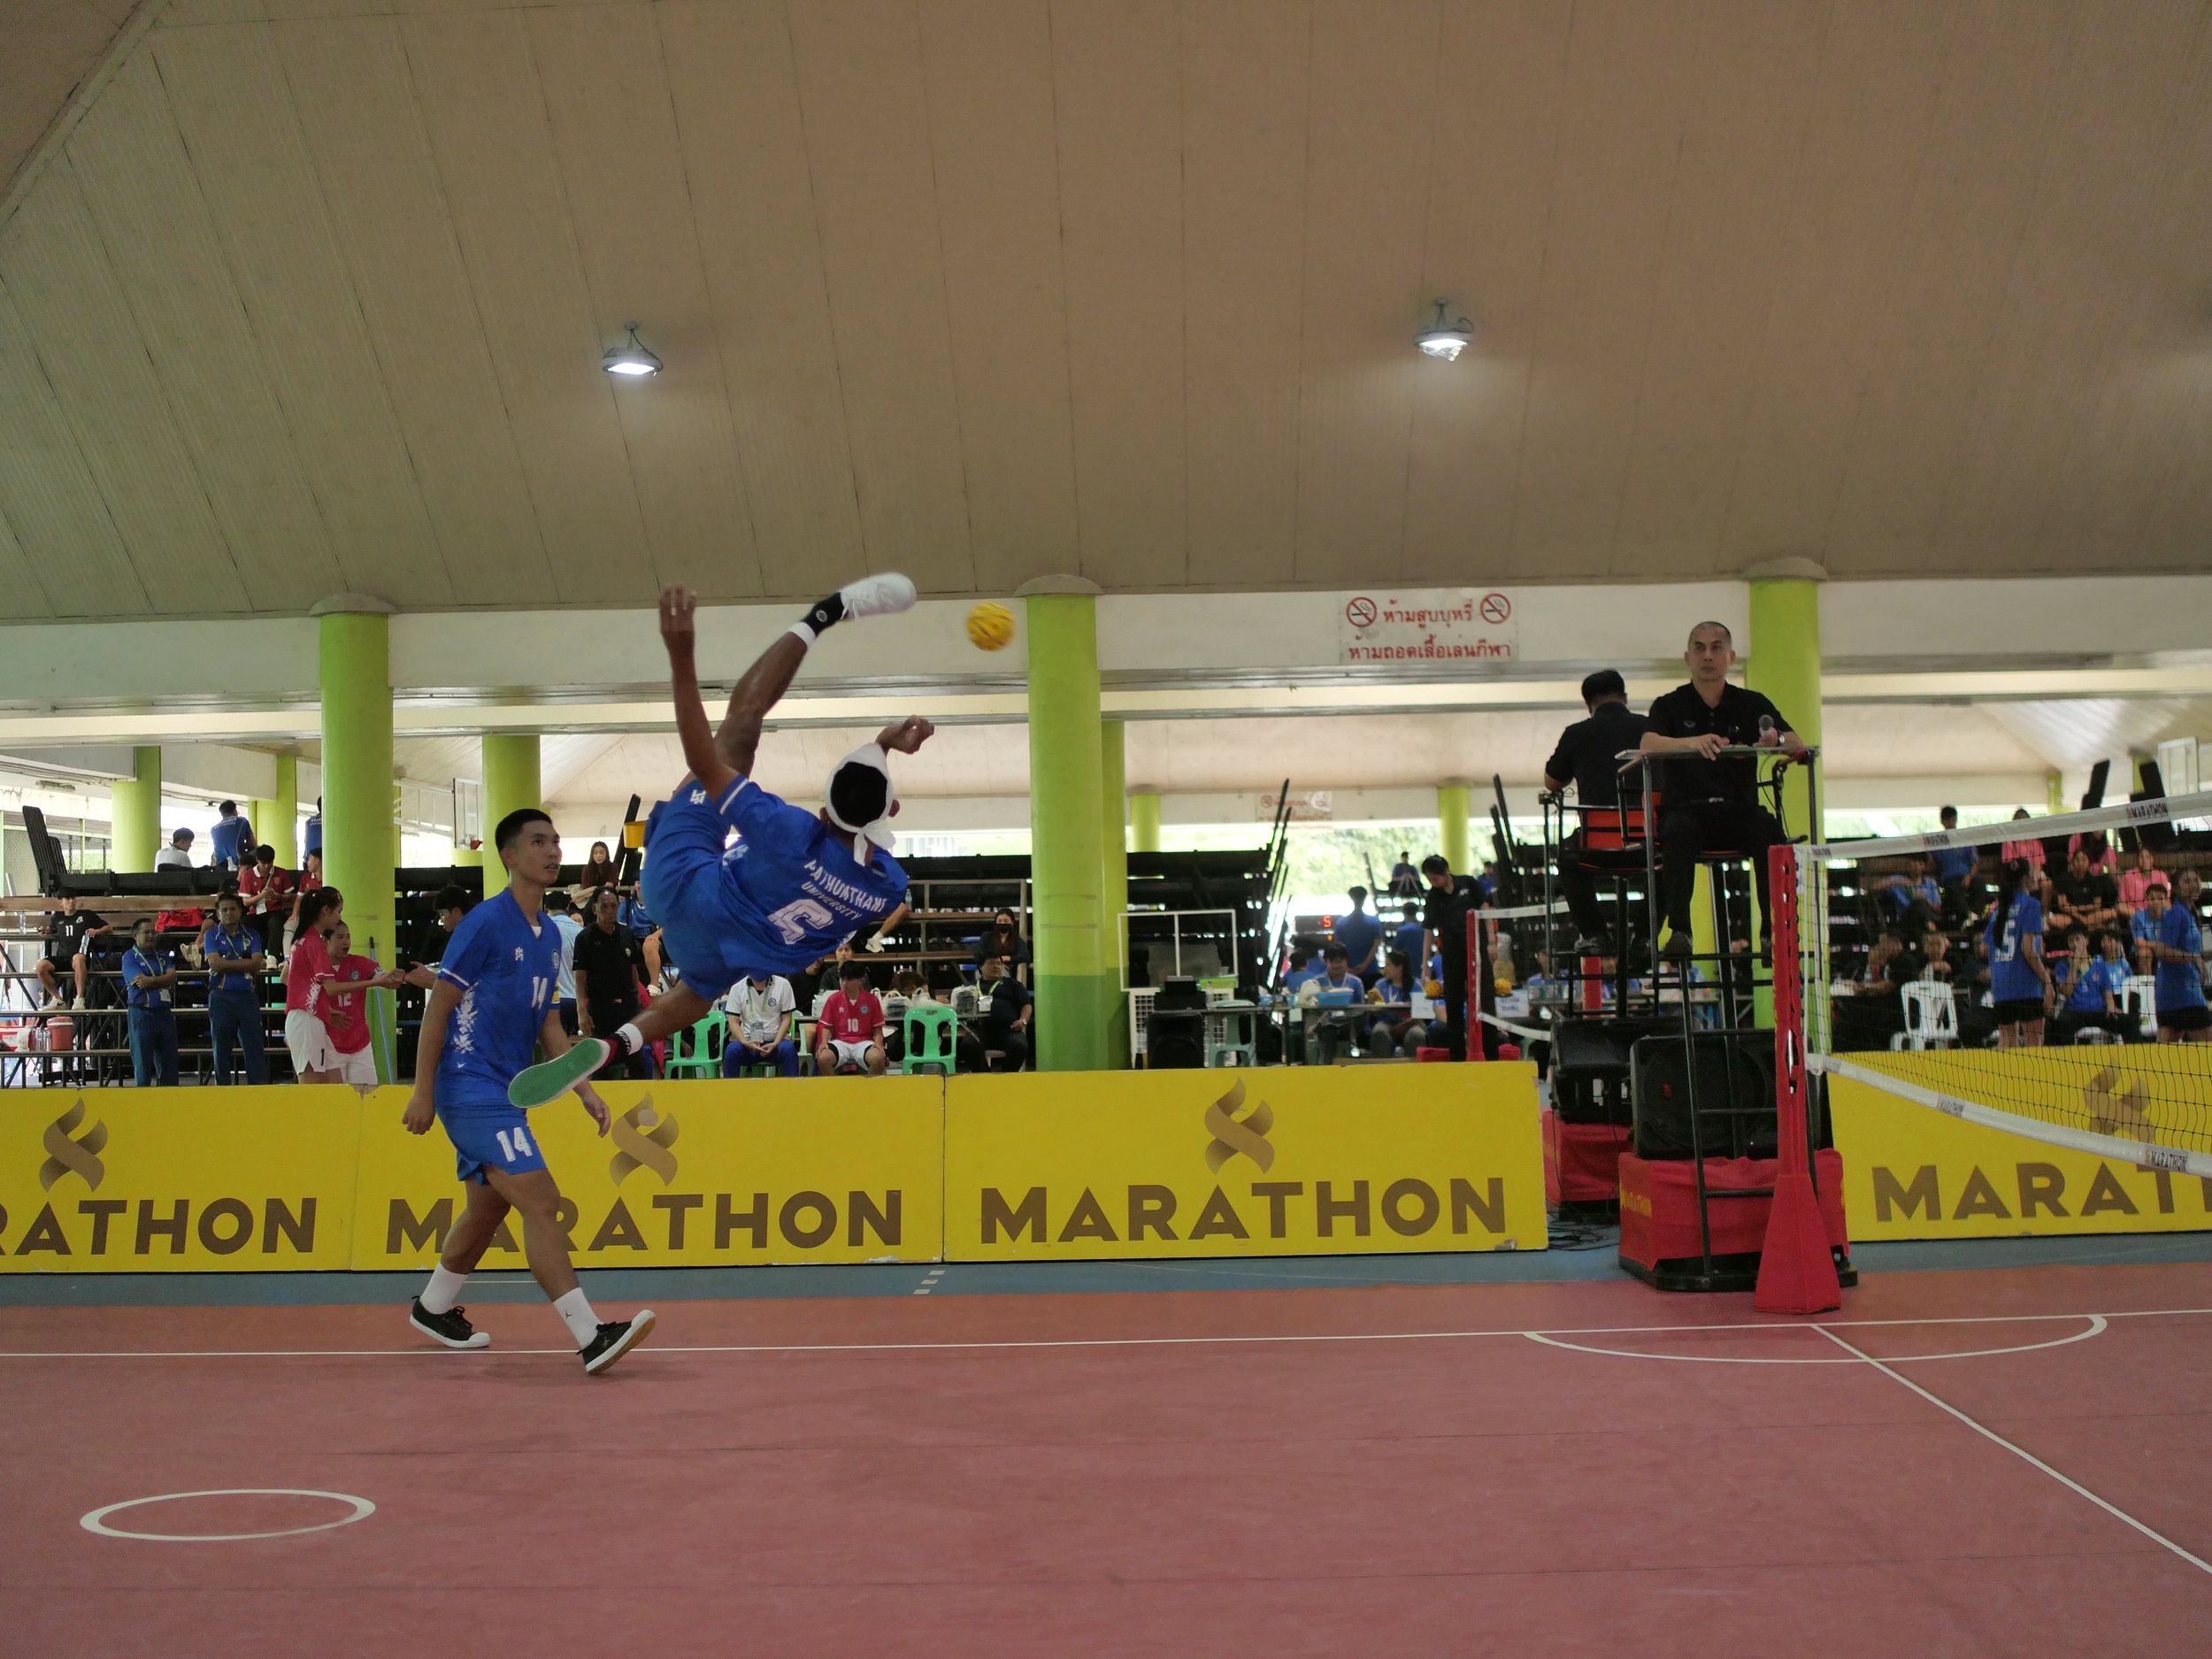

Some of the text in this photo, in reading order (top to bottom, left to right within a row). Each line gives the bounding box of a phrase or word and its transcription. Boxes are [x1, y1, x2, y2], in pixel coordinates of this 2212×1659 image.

[1383, 598, 1473, 628] ห้ามสูบบุหรี่
[1348, 634, 1510, 660] ห้ามถอดเสื้อเล่นกีฬา
[801, 881, 863, 921] UNIVERSITY
[65, 926, 73, 936] 11
[337, 992, 352, 1008] 12
[847, 1018, 858, 1033] 10
[495, 1126, 533, 1162] 14
[1871, 1161, 2212, 1223] MARAT
[980, 1177, 1506, 1244] MARATHON
